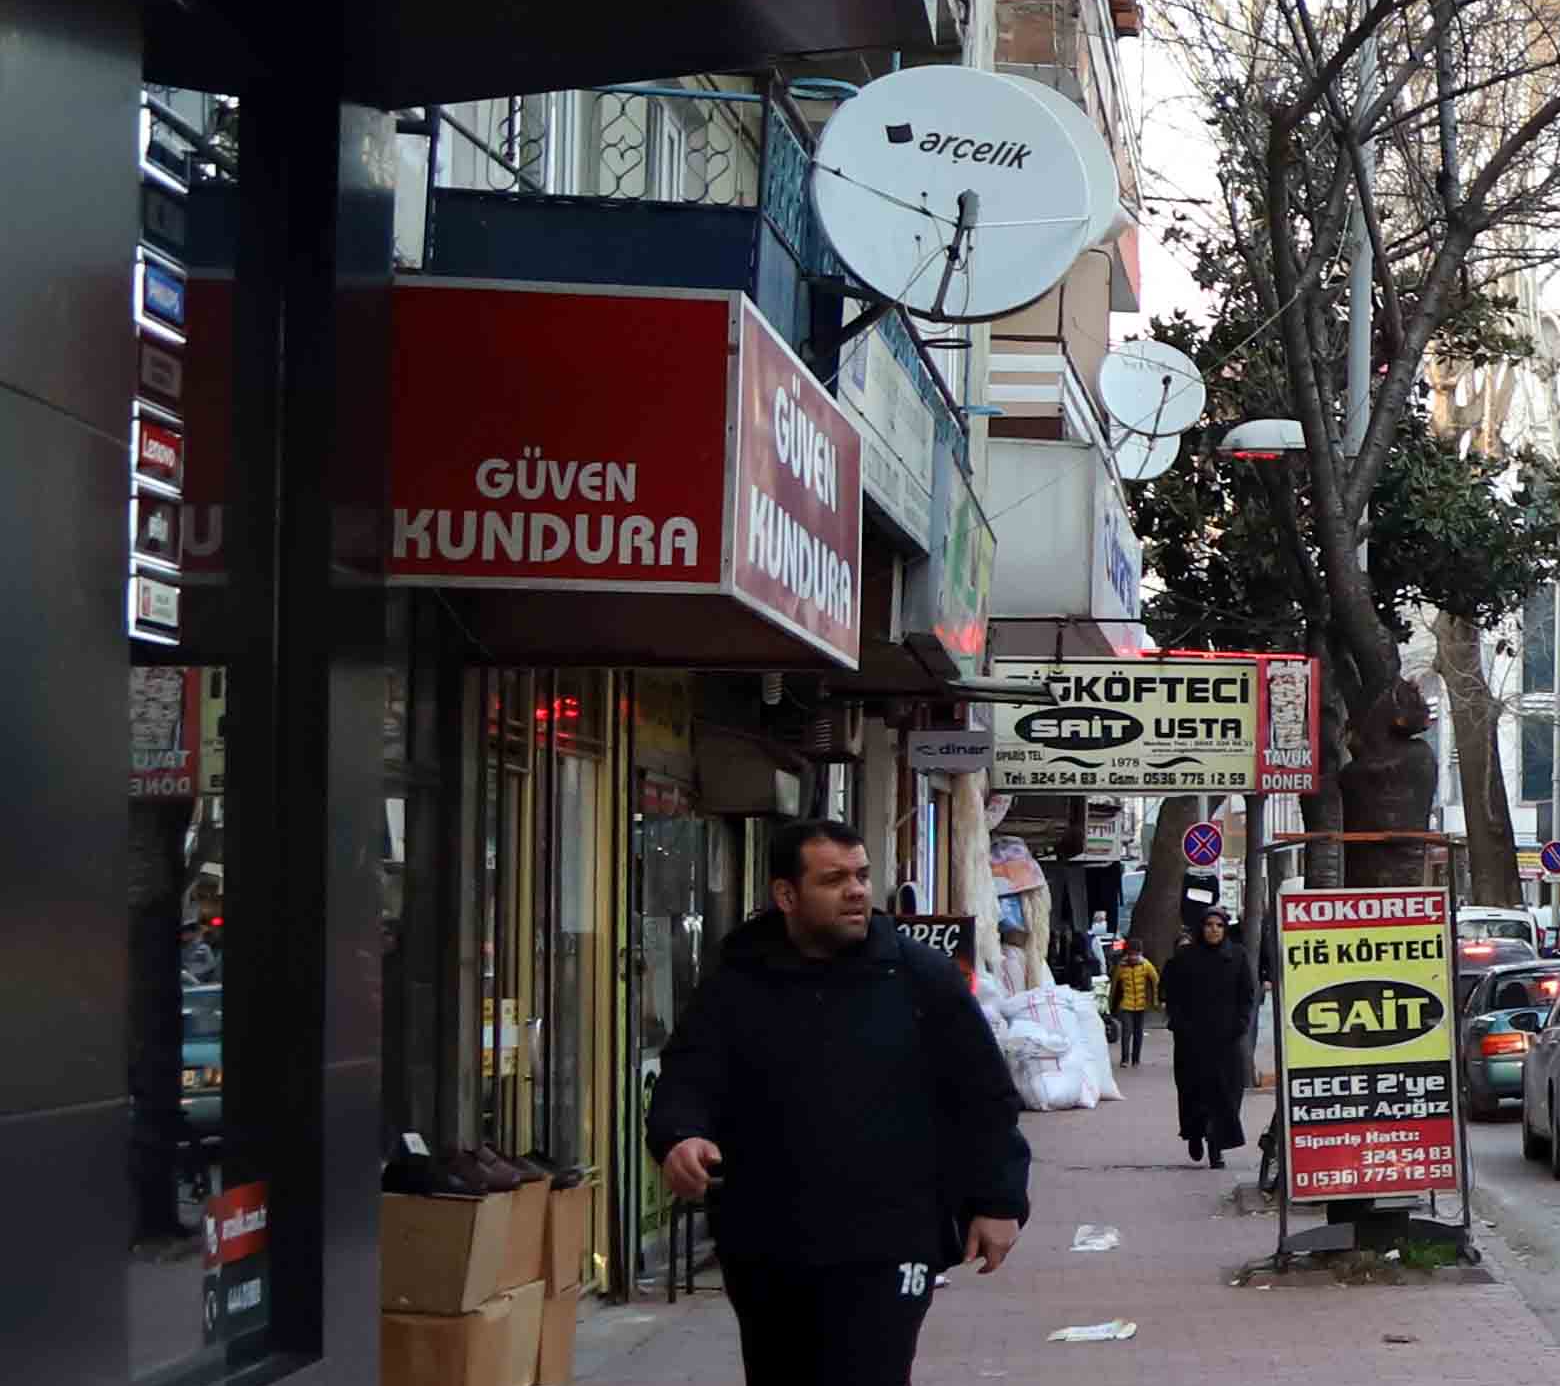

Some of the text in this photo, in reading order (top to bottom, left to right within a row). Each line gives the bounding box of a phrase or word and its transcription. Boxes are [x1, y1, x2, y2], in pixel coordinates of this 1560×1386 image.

[919, 127, 1032, 170] arçelik
[773, 370, 839, 514] GÜVEN
[475, 446, 636, 502] GÜVEN
[393, 508, 698, 567] KUNDURA
[748, 484, 852, 630] KUNDURA
[1007, 668, 1249, 709] ĞKÖFTECİ
[1031, 714, 1242, 739] SAİT USTA
[938, 742, 989, 757] dinar
[1263, 749, 1313, 766] TAVUK
[1030, 772, 1056, 786] 324
[1059, 772, 1077, 786] 54
[1143, 772, 1177, 786] 0536
[1181, 772, 1206, 786] 775
[1210, 772, 1225, 786] 12
[1228, 772, 1246, 786] 59
[1262, 771, 1313, 790] DÖNER
[1286, 896, 1444, 924] KOKOREÇ
[1288, 934, 1444, 970] ÇİĞ KÖFTECİ
[1306, 989, 1430, 1036] SAİT
[1291, 1072, 1446, 1099] GECE 2'ye
[1292, 1099, 1451, 1122] Kadar Açığız
[1295, 1132, 1361, 1150] Sipariş
[1361, 1148, 1425, 1165] 324 54
[1312, 1170, 1359, 1187] (536)
[1362, 1167, 1399, 1184] 775
[1402, 1166, 1426, 1181] 12
[1428, 1164, 1454, 1179] 59
[897, 1262, 930, 1298] 16
